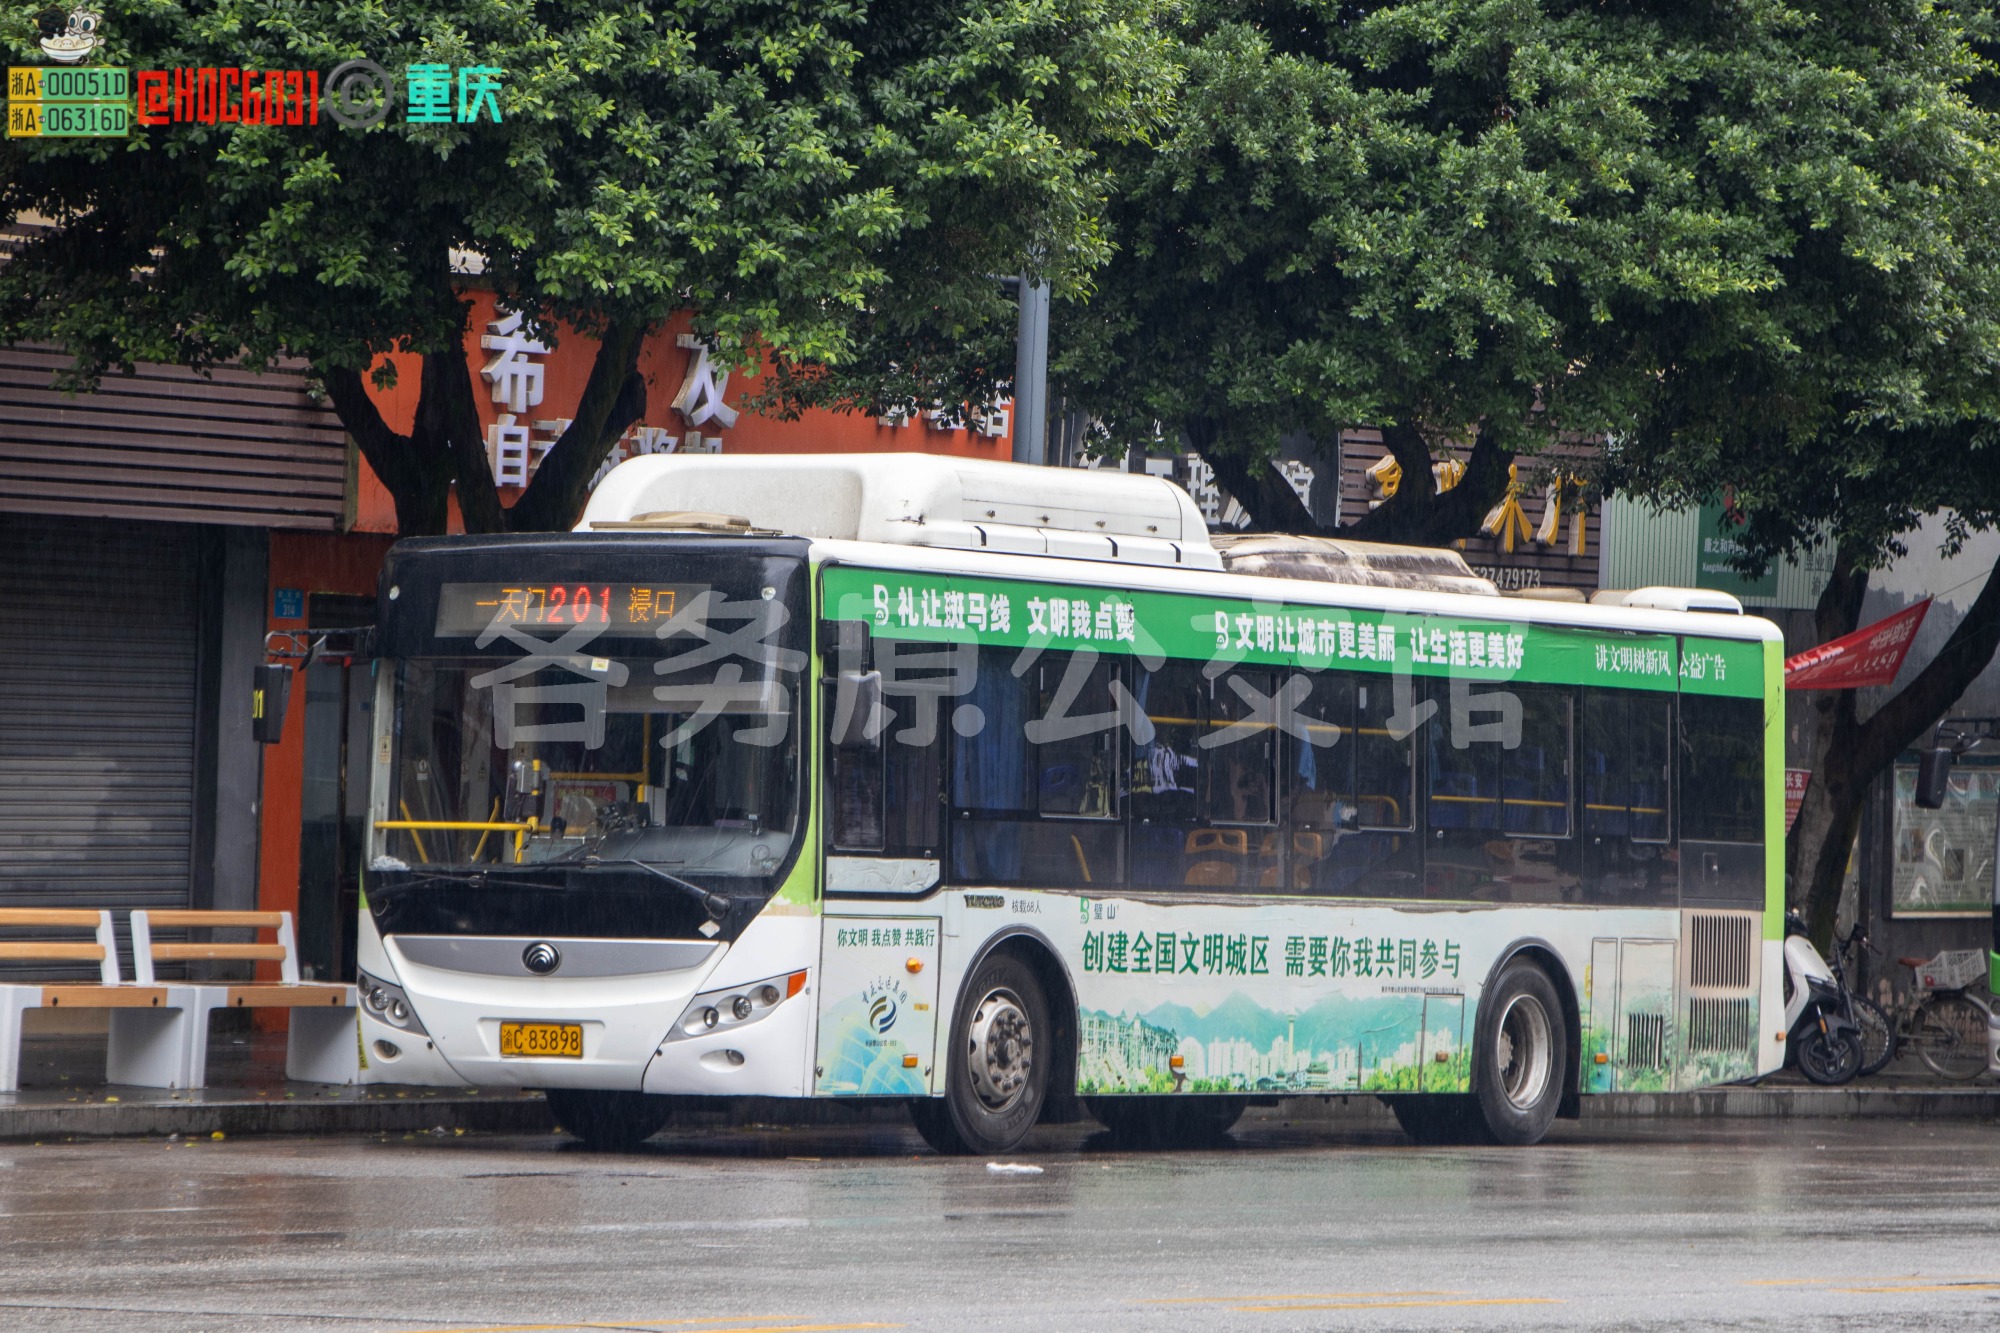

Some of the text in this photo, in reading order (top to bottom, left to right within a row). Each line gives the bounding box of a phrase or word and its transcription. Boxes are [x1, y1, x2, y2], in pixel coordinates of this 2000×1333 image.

[547, 585, 611, 623] 201
[898, 586, 1011, 634] 礼让斑马线
[1026, 596, 1136, 643] 文明我点赞
[1235, 613, 1396, 662] 文明让城市更美丽
[1410, 627, 1525, 670] 让生活更美好
[1595, 644, 1727, 681] 讲文明树新风 公益广告
[837, 928, 935, 949] 你文明 我点赞 共践行
[1082, 929, 1461, 980] 创建全国文明城区 需要你我共同参与
